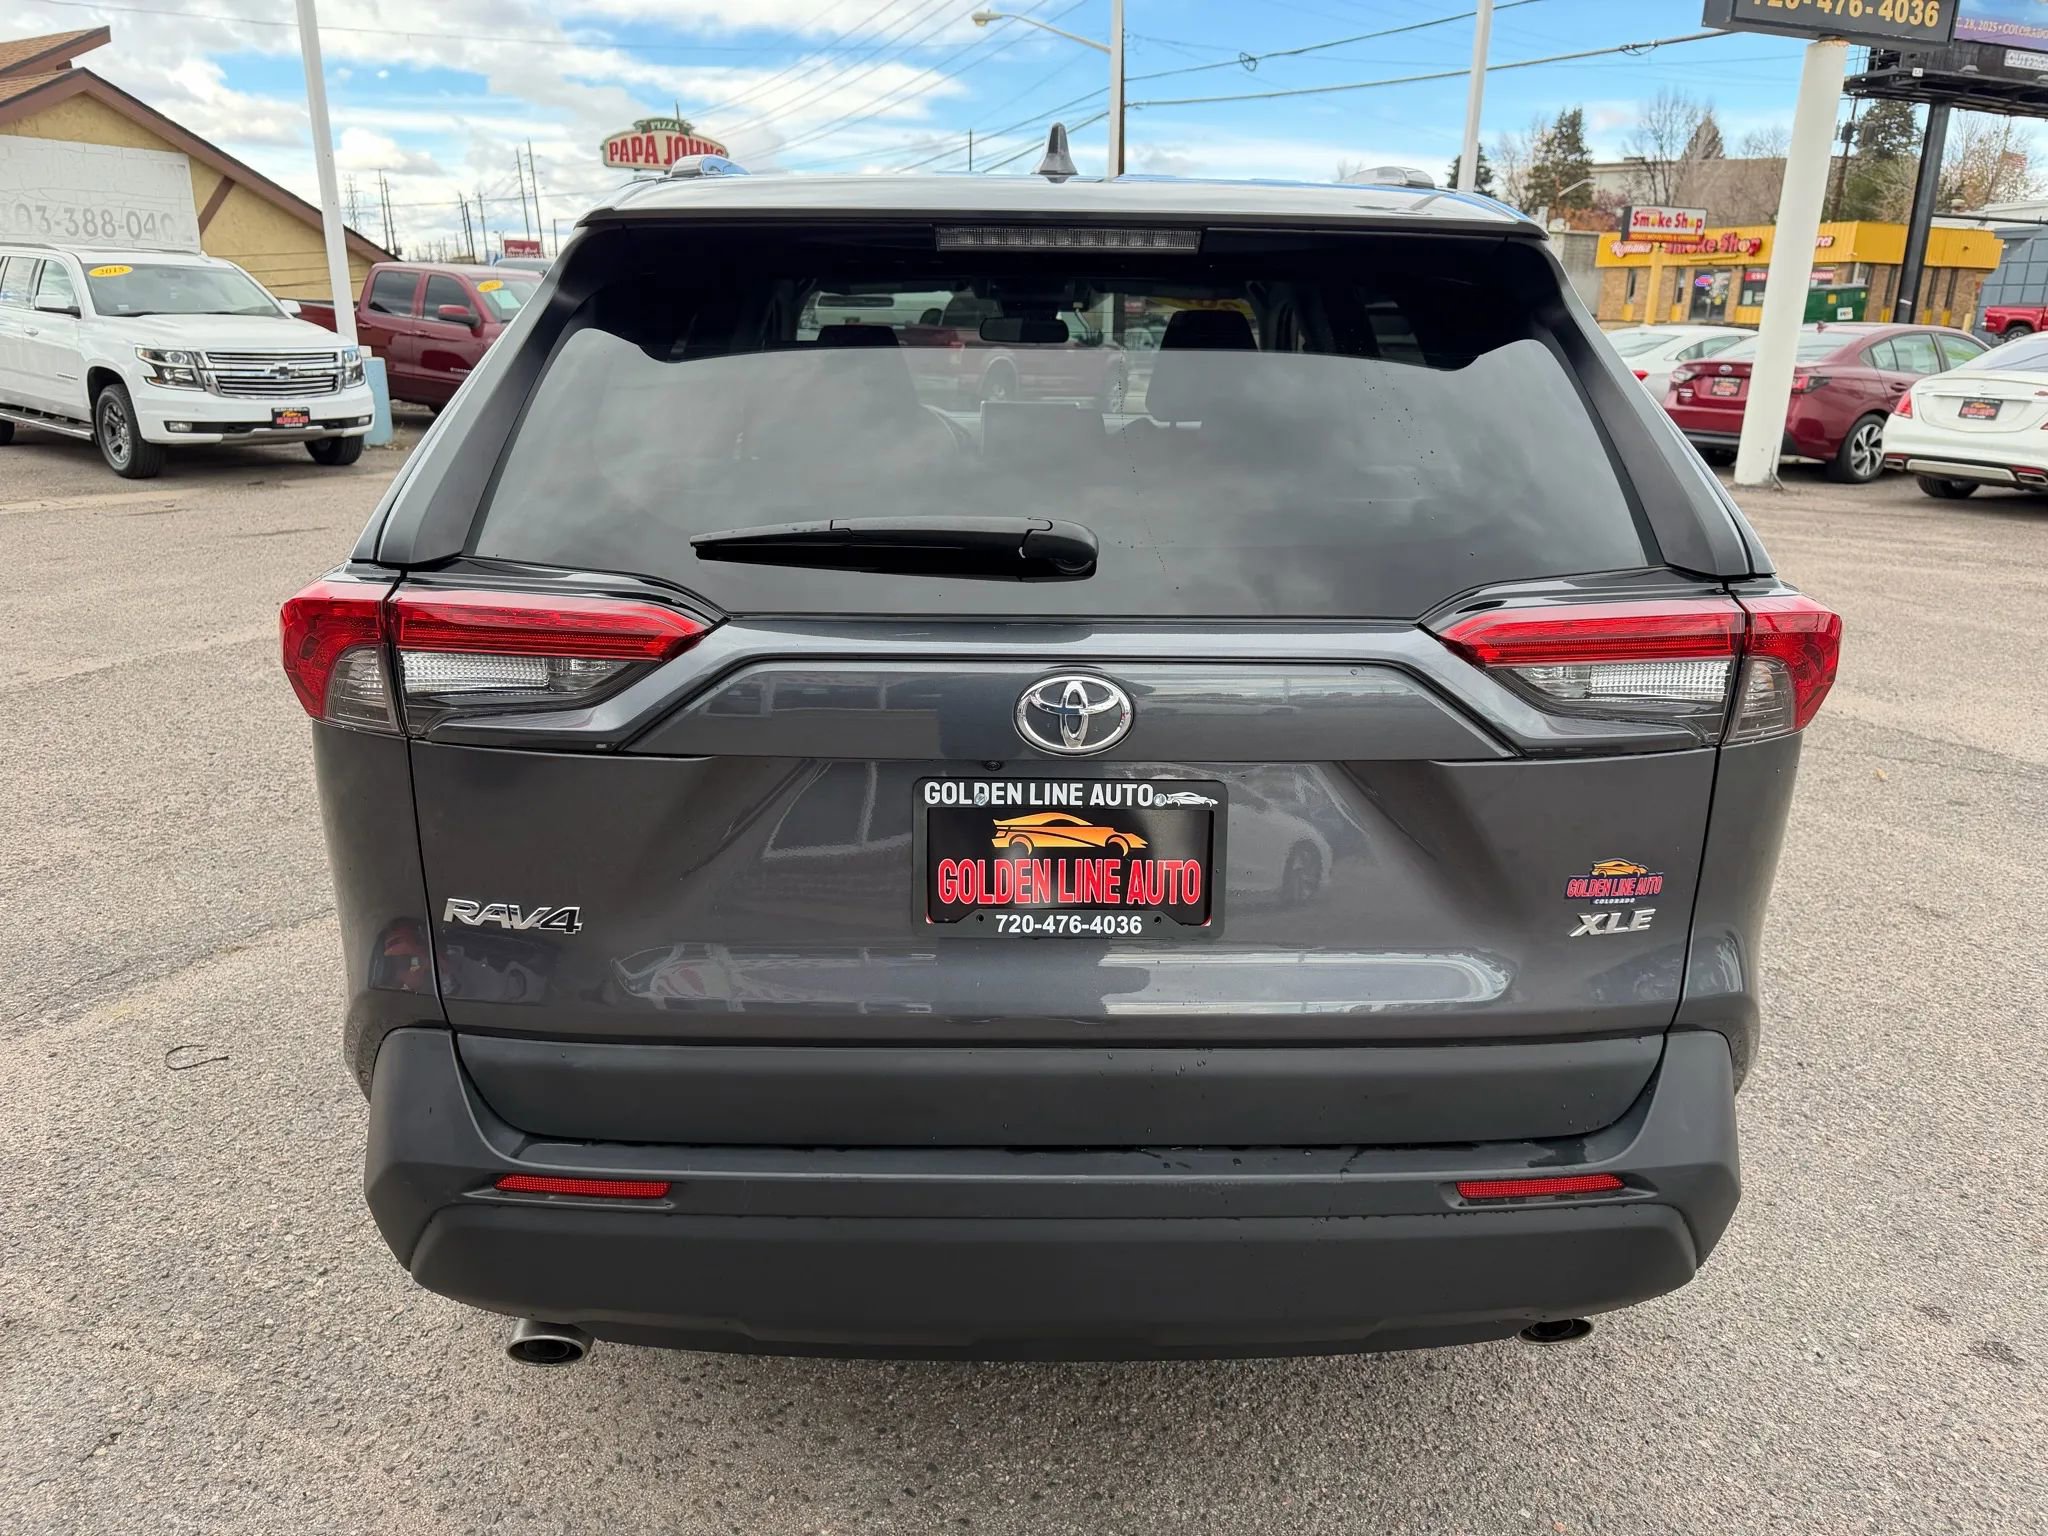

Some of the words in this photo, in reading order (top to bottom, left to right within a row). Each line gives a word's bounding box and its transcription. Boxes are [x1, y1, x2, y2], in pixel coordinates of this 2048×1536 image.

[650, 121, 680, 131] PIZZA
[608, 135, 659, 164] PAPA
[924, 782, 1022, 806] GOLDEN
[1029, 783, 1083, 806] LINE
[1089, 783, 1154, 807] AUTO
[938, 858, 1051, 905] GOLDEN
[1057, 858, 1121, 905] LINE
[1126, 859, 1201, 906] AUTO
[1567, 878, 1613, 897] GOLDEN
[1610, 878, 1637, 897] LINE
[1634, 875, 1662, 896] AUTO
[443, 898, 583, 934] RAV4
[995, 914, 1142, 934] 720-476-4036
[1569, 908, 1656, 937] XLE
